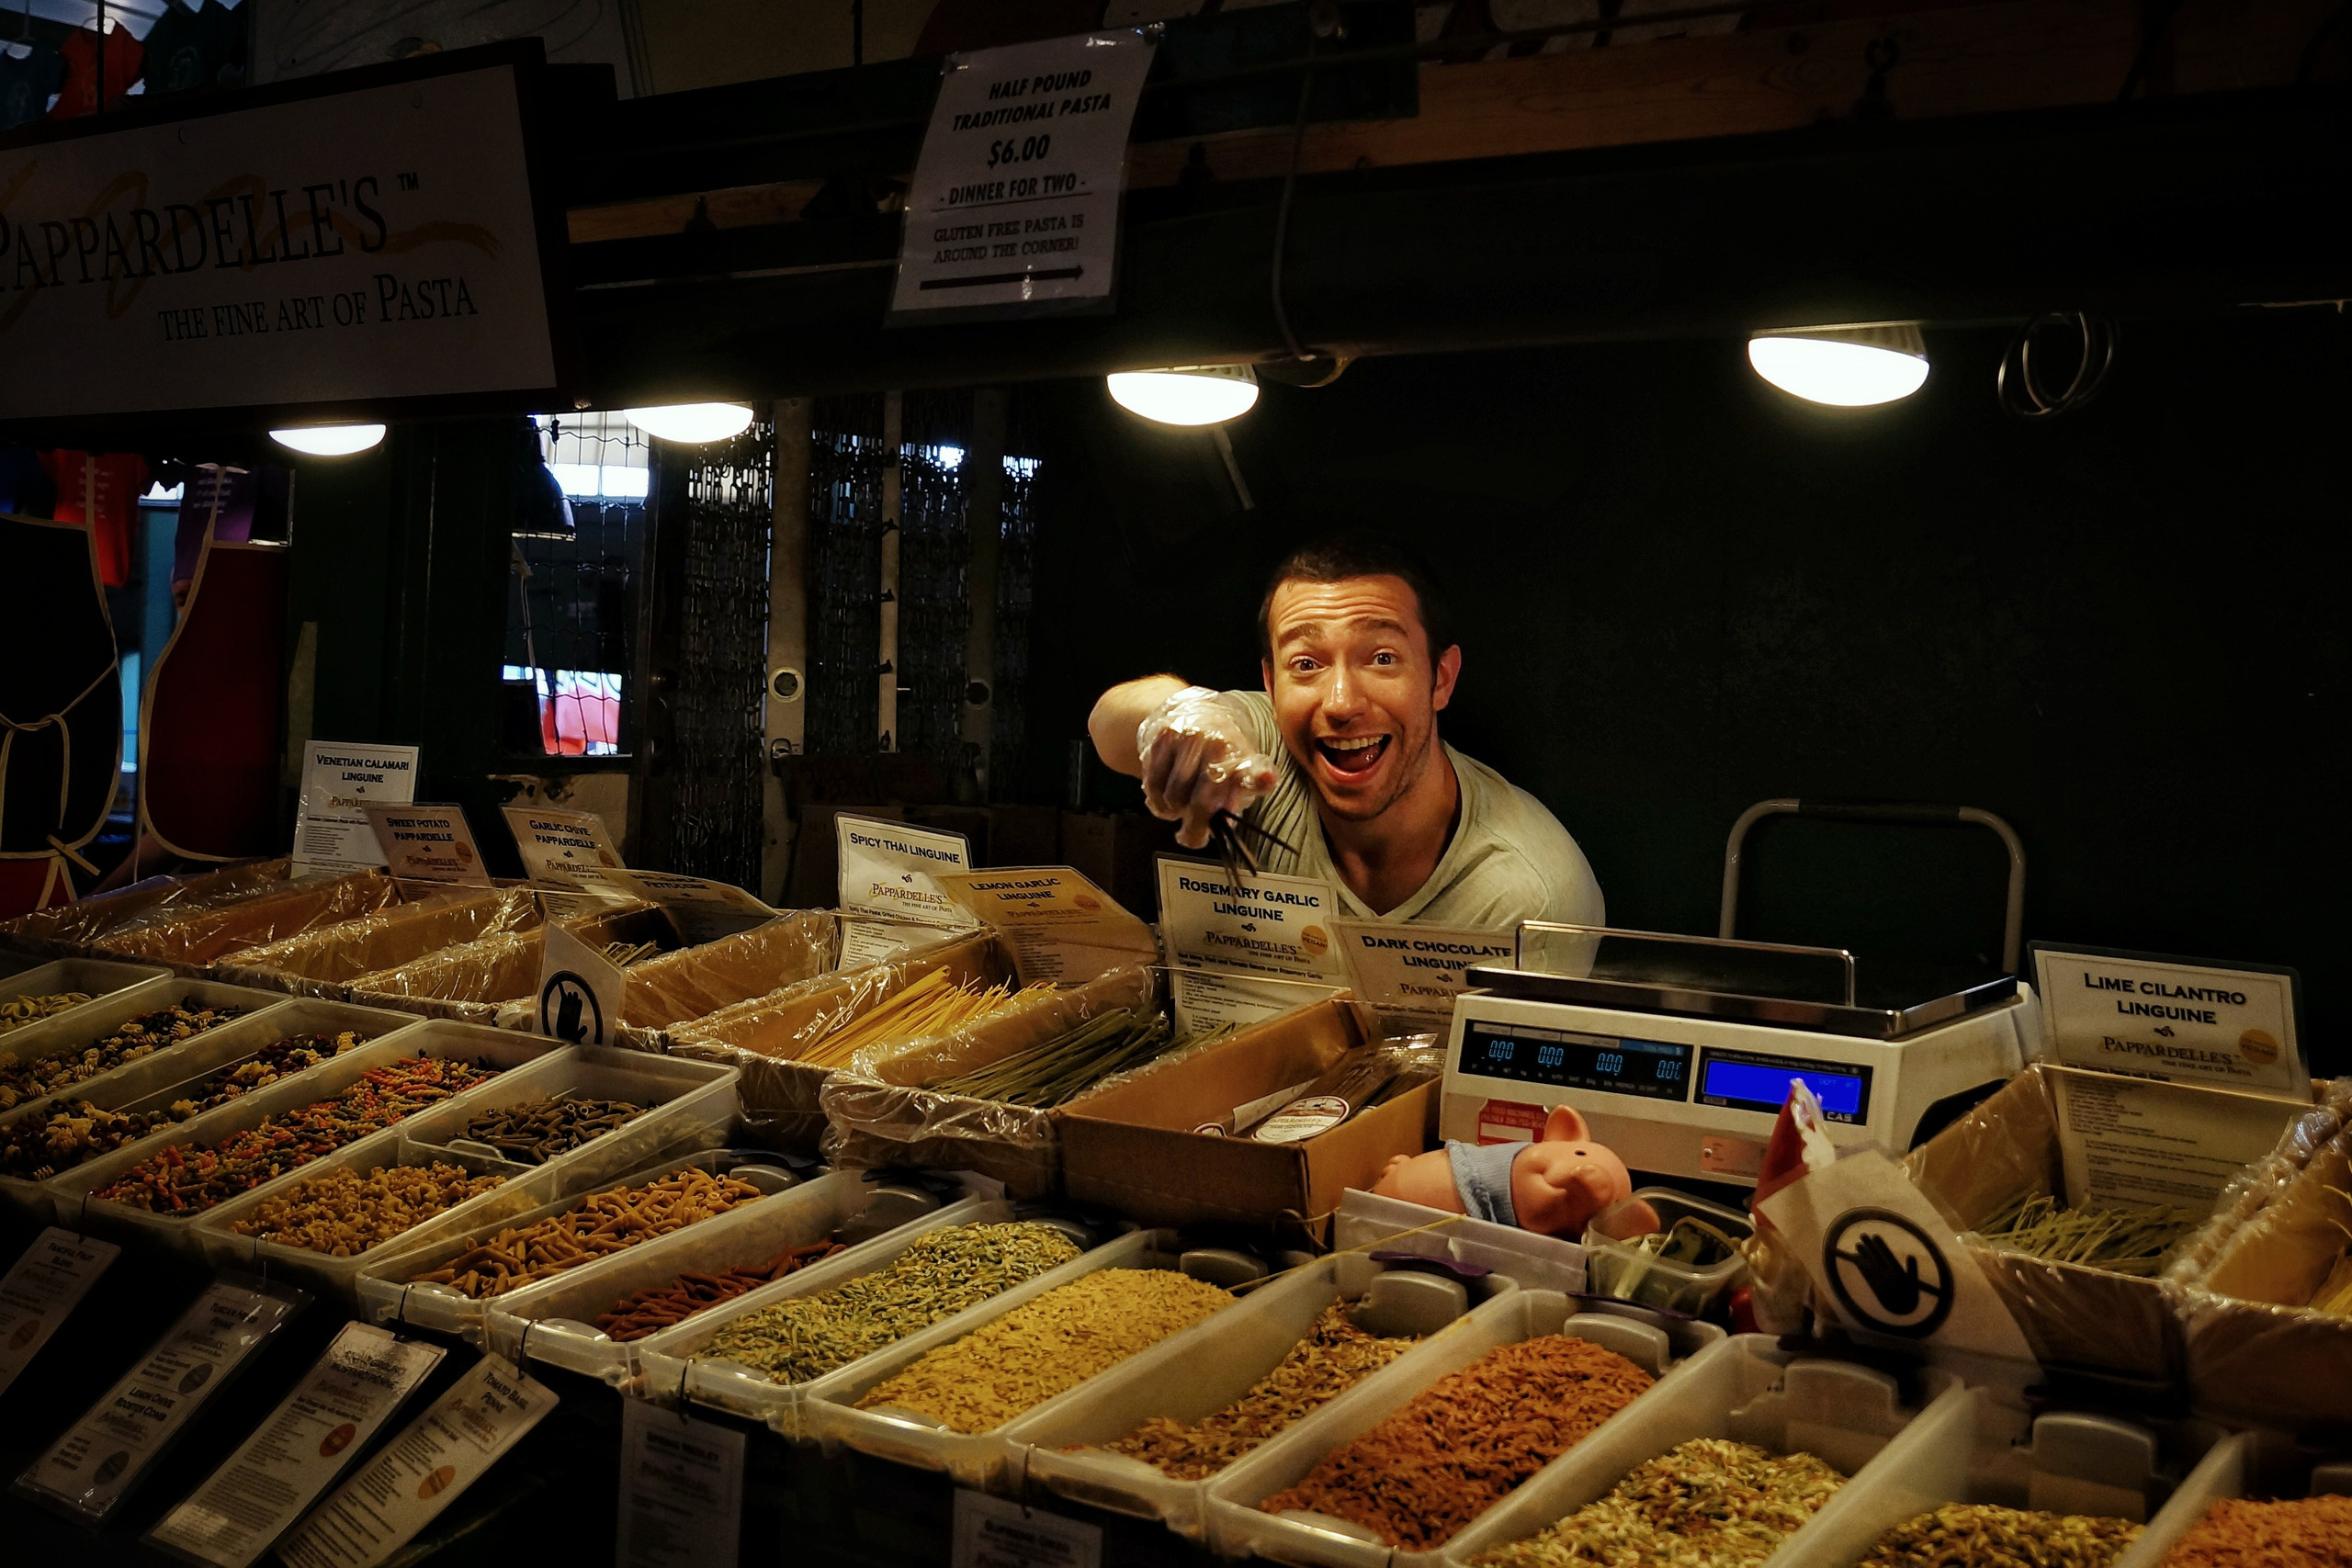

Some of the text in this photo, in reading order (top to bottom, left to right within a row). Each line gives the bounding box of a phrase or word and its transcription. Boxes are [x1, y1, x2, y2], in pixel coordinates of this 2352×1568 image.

[989, 70, 1091, 100] HALF POUND
[953, 94, 1111, 131] TRADITIONAL PASTA
[988, 135, 1050, 168] $6.00
[949, 183, 1003, 205] DINNER
[1010, 179, 1036, 197] FOR
[1043, 174, 1076, 193] TWO
[933, 214, 1084, 243] GLUTEN FREE PASTA IS
[933, 237, 1079, 264] AROUND THE CORNER!
[158, 273, 478, 342] THE FINE ART OF PASTA
[316, 754, 409, 771] VENETIAN CALAMARI
[342, 772, 384, 783] LINGUINE
[387, 818, 450, 828] SWEET POTATO
[529, 819, 591, 836] GARLIC CHIVE
[394, 832, 454, 841] PAPPARDELLE
[536, 834, 595, 849] PAPPARDELLE
[850, 832, 961, 863] SPICY THAI LINGUINE
[873, 883, 943, 905] PAPPARDELLE'S
[968, 878, 1061, 891] LEMON GARLIC
[996, 890, 1056, 900] LINGUINE
[1179, 877, 1320, 908] ROSEMARY GARLIC
[1213, 901, 1284, 922] LINGUINE
[1205, 931, 1298, 955] PAPPARDELLE'S
[1361, 935, 1512, 957] DARK CHOCOLATE
[1403, 955, 1473, 970] LINGUIN
[2085, 973, 2246, 1006] LIME CILANTRO
[2118, 1001, 2216, 1024] LINGUINE
[2103, 1036, 2233, 1065] PAPPARDELLE'S
